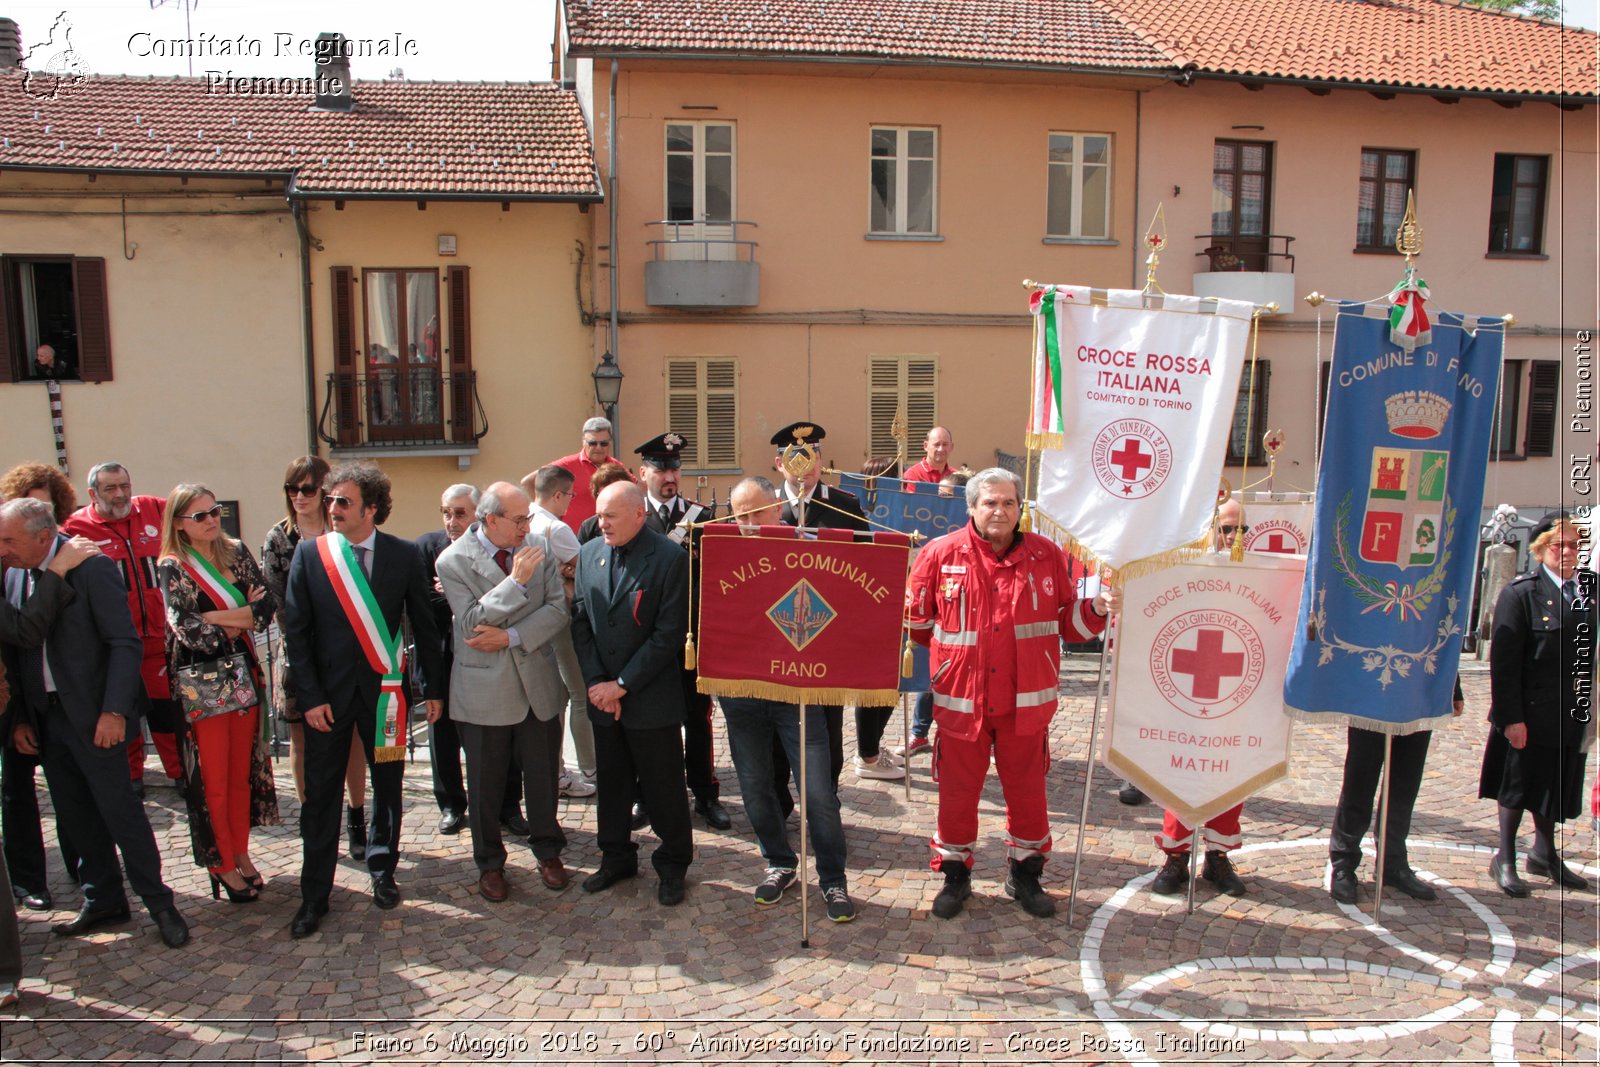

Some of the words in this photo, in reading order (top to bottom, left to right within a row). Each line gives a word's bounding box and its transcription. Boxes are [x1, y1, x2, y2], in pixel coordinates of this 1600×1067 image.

[1077, 345, 1137, 368] CROCE
[1146, 354, 1212, 376] ROSSA
[1339, 351, 1414, 388] COMUNE
[1426, 351, 1438, 367] DI
[1097, 371, 1182, 395] ITALIANA
[1086, 390, 1135, 406] COMITATO
[1138, 397, 1149, 407] DI
[1154, 399, 1193, 411] TORINO
[1095, 432, 1116, 486] CONVENZIONE
[1108, 425, 1119, 437] DI
[1120, 421, 1155, 439] GINEVRA
[1155, 448, 1170, 478] AGOSTO
[1281, 520, 1308, 548] ITALIANA
[1371, 522, 1392, 552] F
[719, 557, 777, 595] A.V.I.S.
[785, 552, 890, 604] COMUNALE
[1143, 586, 1184, 618] CROCE
[1187, 579, 1231, 593] ROSSA
[1236, 584, 1282, 625] ITALIANA
[1176, 618, 1188, 630] DI
[1189, 613, 1238, 629] GINEVRA
[1238, 624, 1252, 638] 22
[770, 660, 827, 678] FIANO
[1153, 625, 1178, 699] CONVENZIONE
[1247, 637, 1262, 682] AGOSTO
[1233, 684, 1252, 704] 1864
[1139, 727, 1241, 748] DELEGAZIONE
[1248, 736, 1262, 747] DI
[1171, 754, 1229, 773] MATHI
